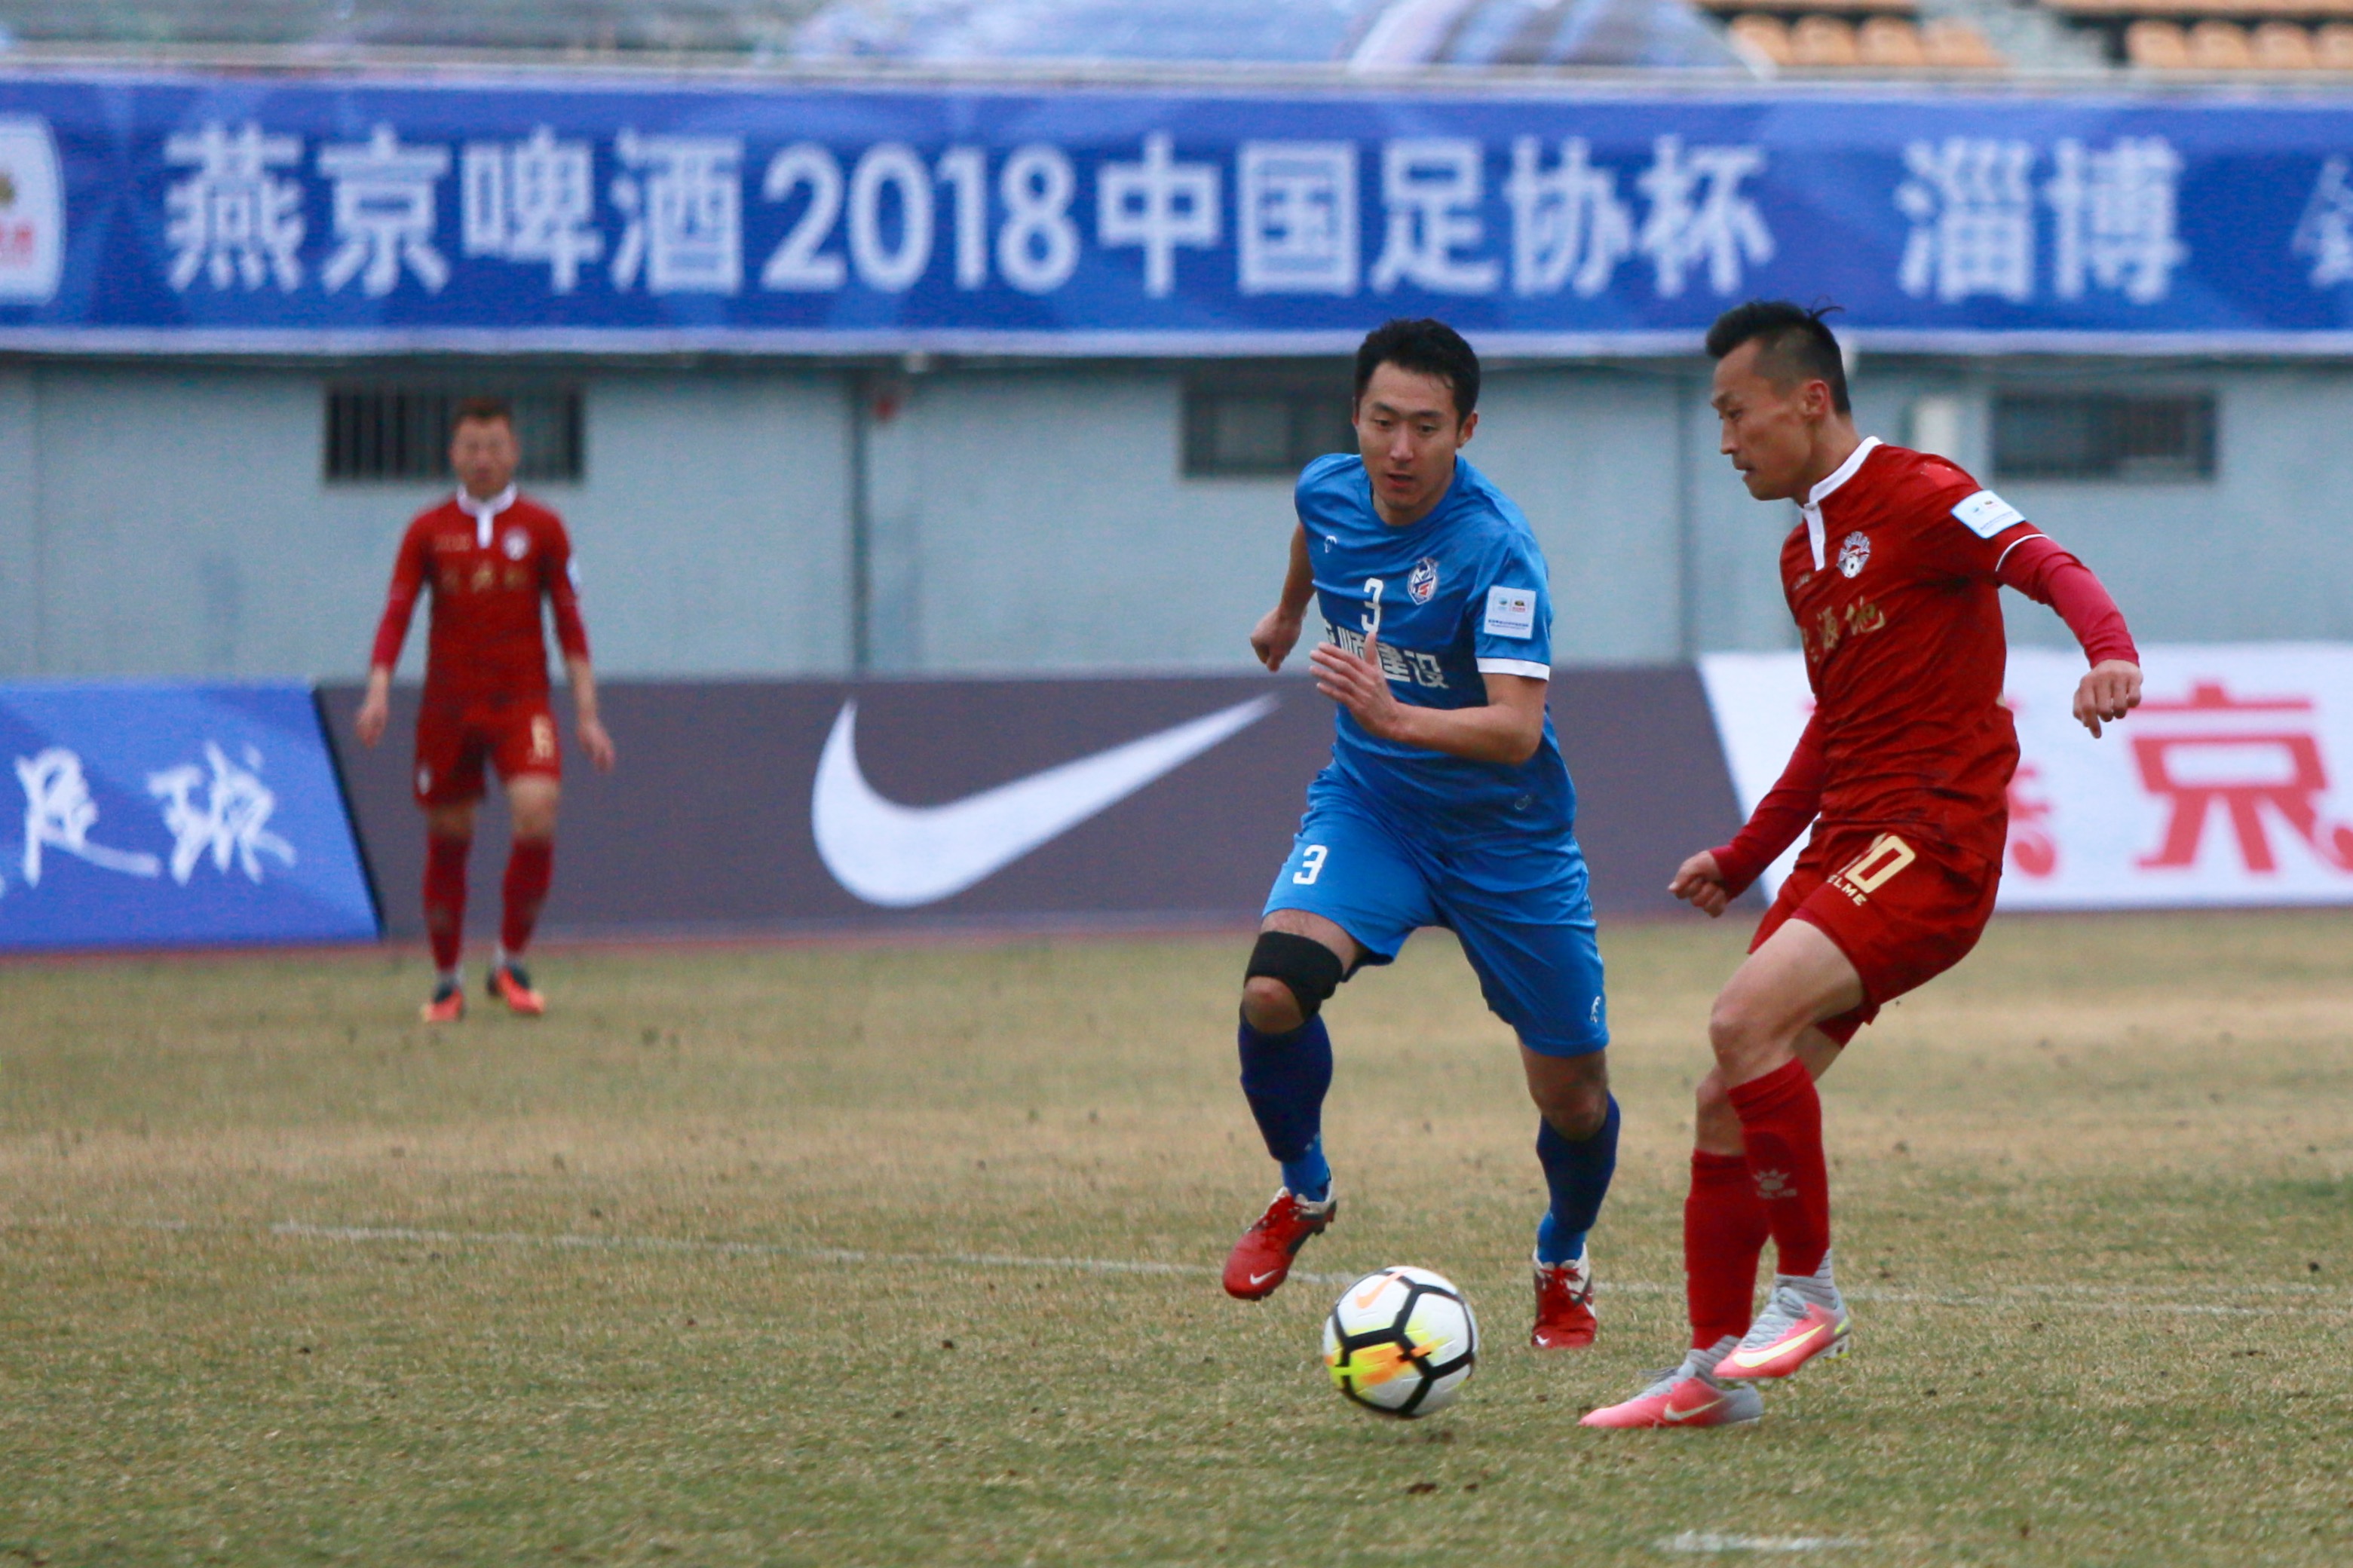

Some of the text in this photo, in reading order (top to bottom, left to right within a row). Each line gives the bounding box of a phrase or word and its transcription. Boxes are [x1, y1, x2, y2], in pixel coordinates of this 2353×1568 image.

[161, 121, 1775, 300] 燕京啤酒2018中国足协杯
[1892, 132, 2189, 305] 淄博
[1360, 577, 1384, 632] 3
[1292, 844, 1328, 885] 3
[1826, 874, 1868, 907] ELME
